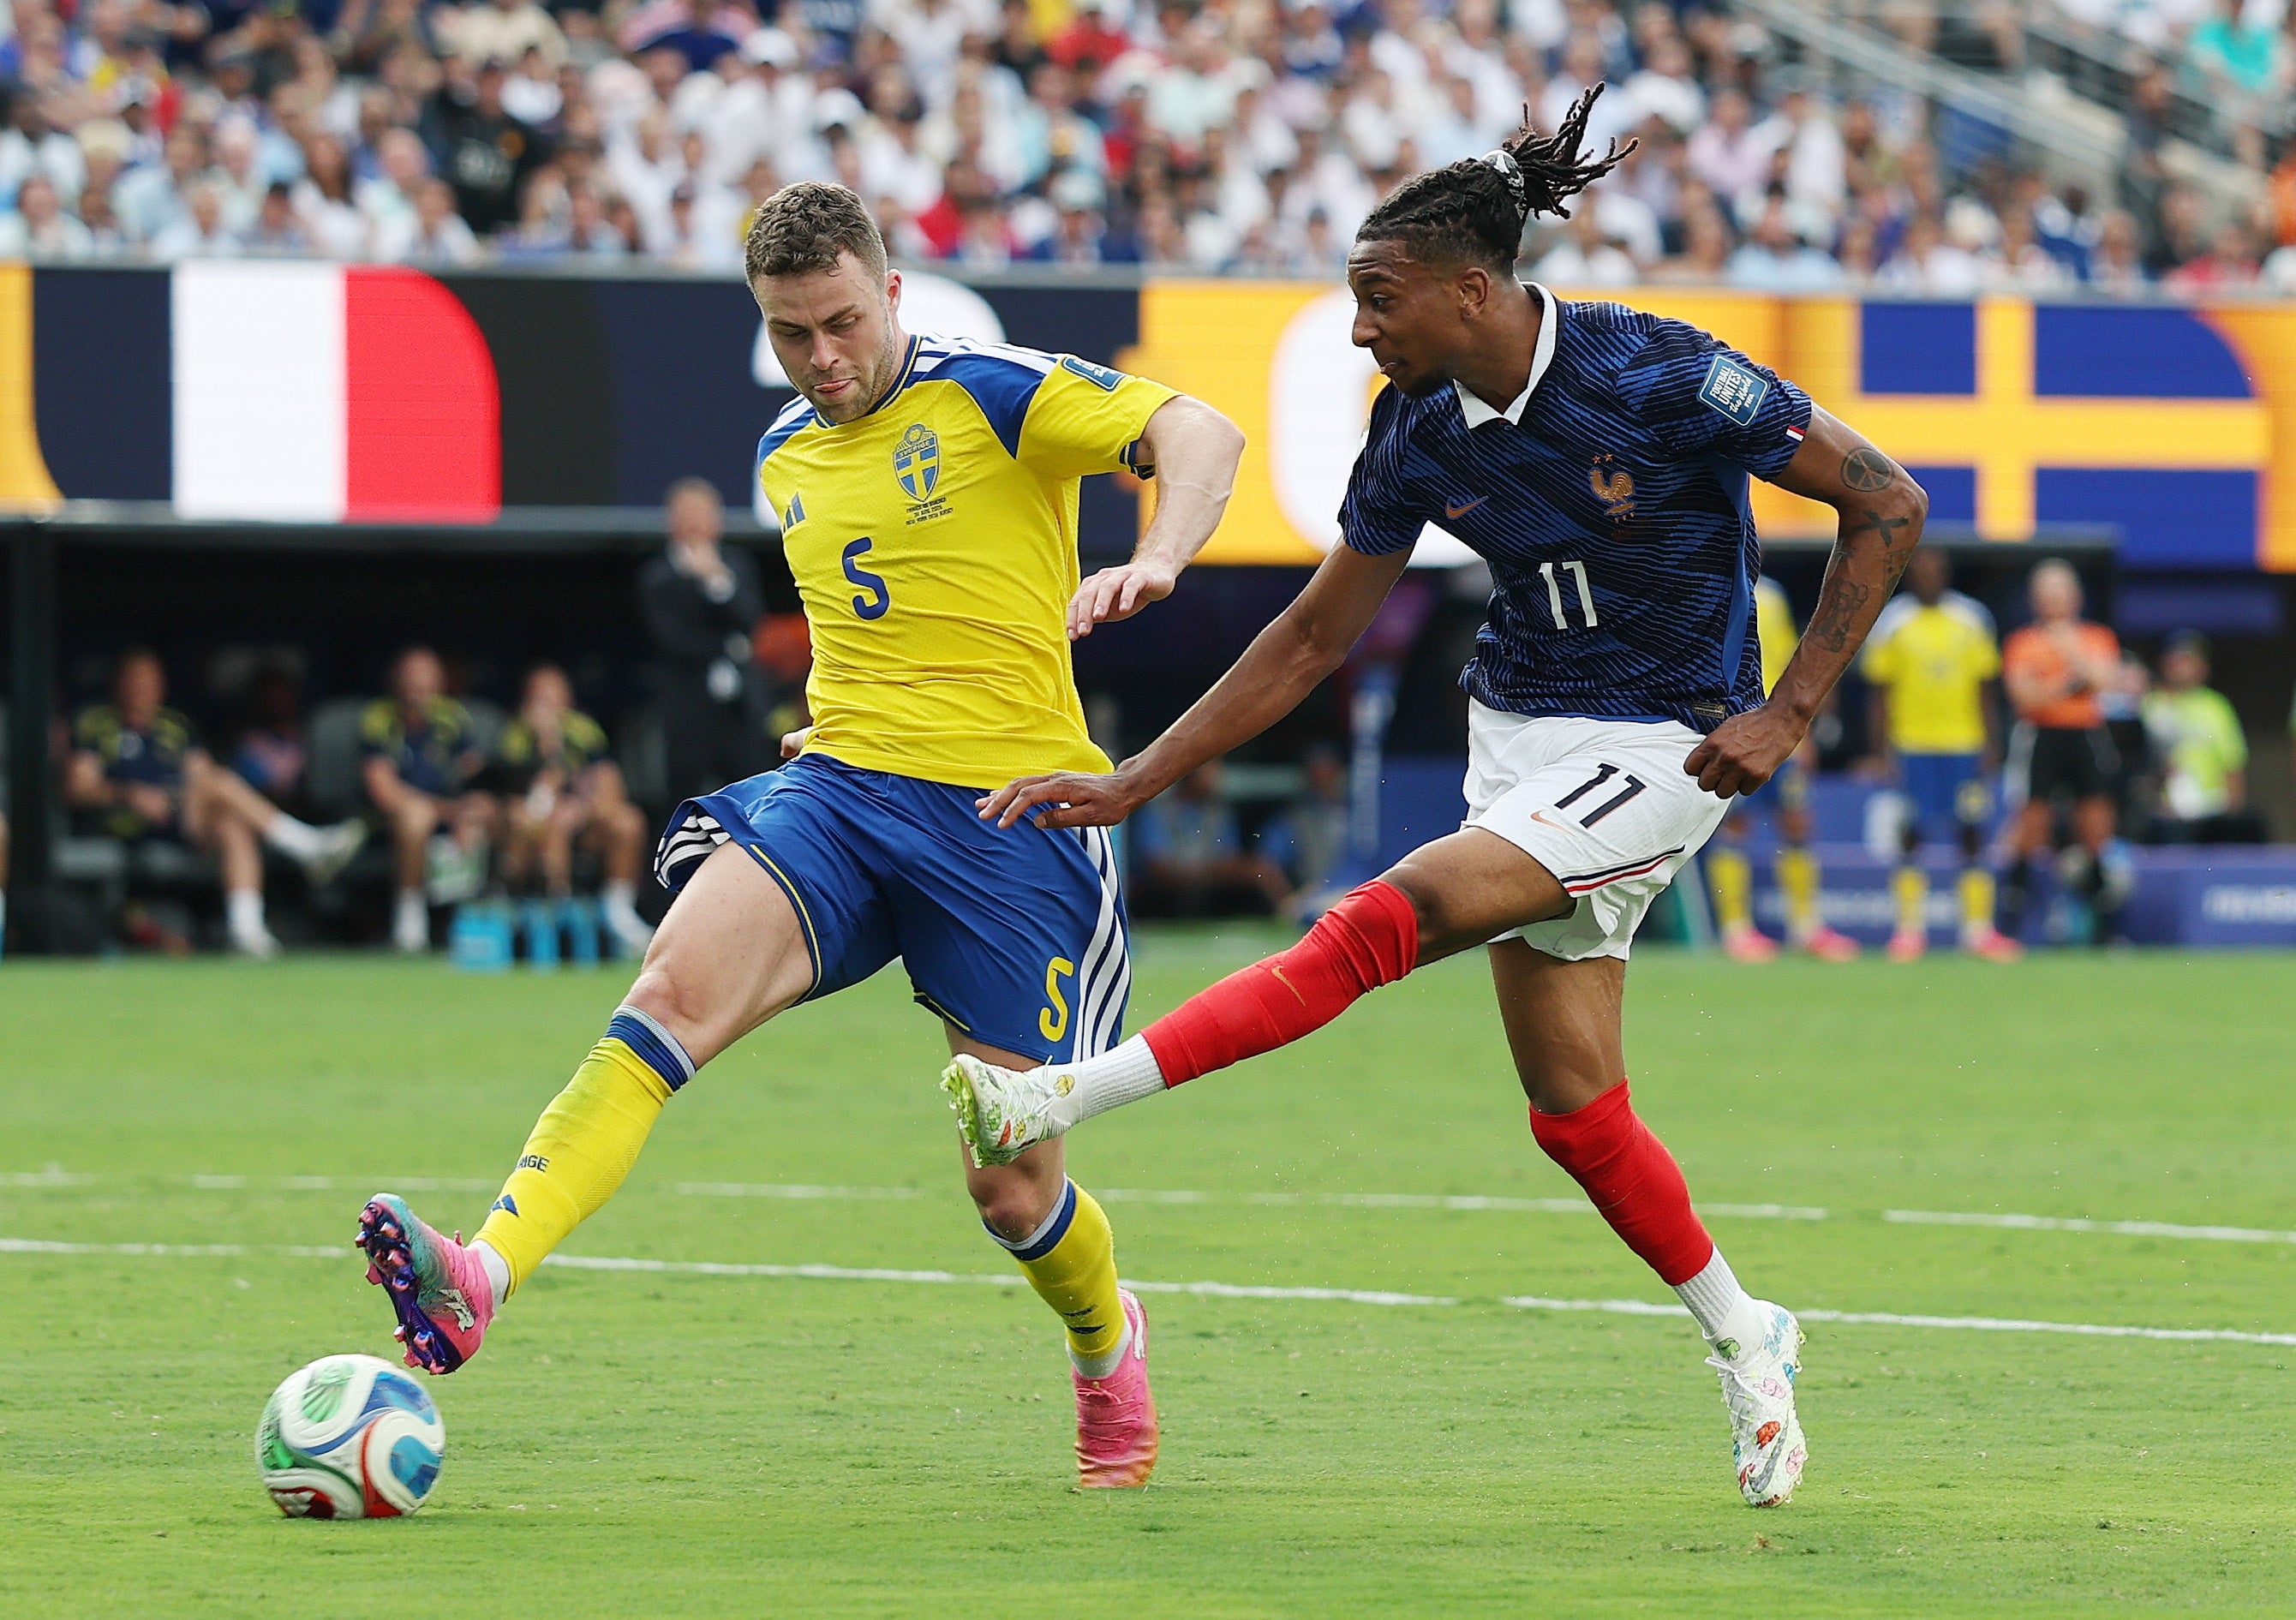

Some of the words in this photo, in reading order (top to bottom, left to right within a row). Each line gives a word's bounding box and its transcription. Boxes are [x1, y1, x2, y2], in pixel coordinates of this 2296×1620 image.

[1709, 365, 1731, 399] FOOTBALL
[1717, 369, 1742, 405] UNITES
[1735, 374, 1754, 401] World
[1729, 398, 1743, 413] the
[1743, 392, 1755, 409] FIFA
[842, 536, 890, 620] 5
[1538, 560, 1598, 630] 11
[1554, 762, 1647, 829] 11
[1038, 956, 1074, 1042] 5
